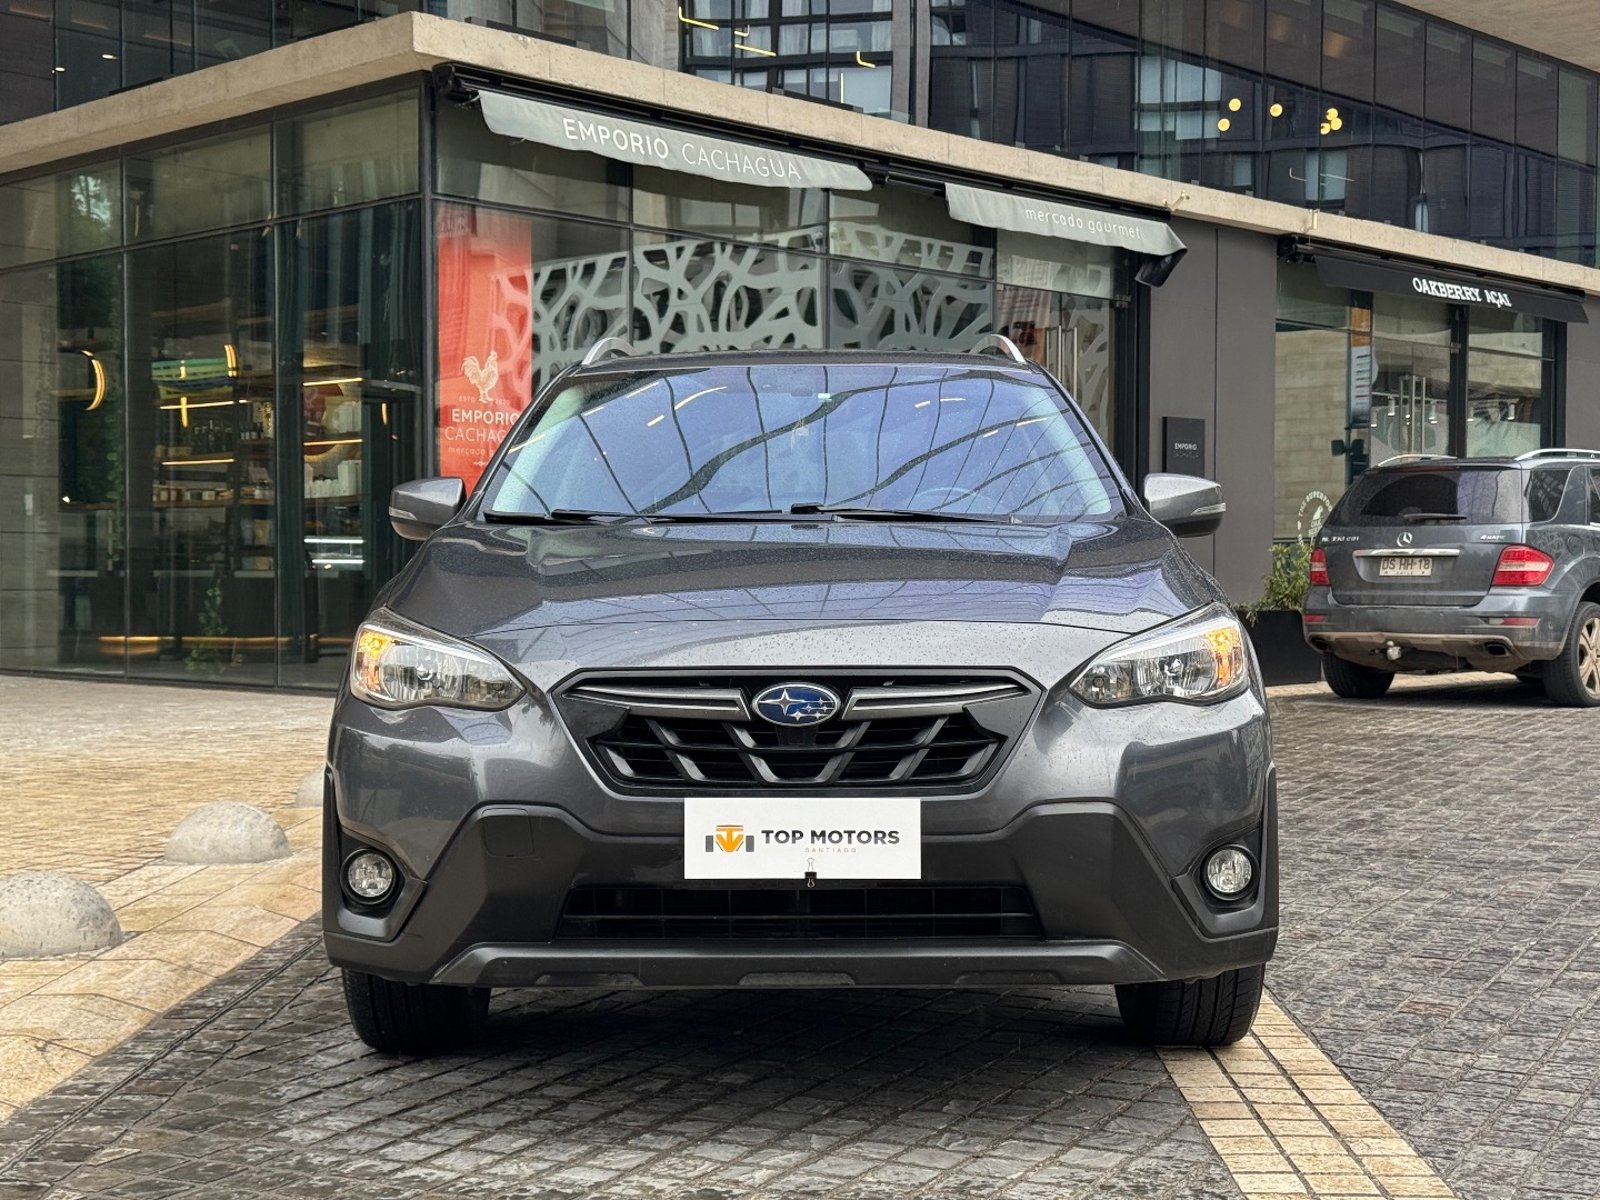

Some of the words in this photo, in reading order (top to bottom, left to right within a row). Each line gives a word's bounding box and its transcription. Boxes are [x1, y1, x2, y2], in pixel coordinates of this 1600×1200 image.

[562, 118, 669, 159] EMPORIO
[681, 143, 801, 180] CACHAGUA
[1025, 209, 1083, 229] mercado
[1088, 220, 1141, 239] gourmet
[1412, 277, 1482, 302] OAKBERRY
[451, 408, 520, 425] EMPORIO
[761, 830, 804, 844] TOP
[810, 830, 900, 845] MOTORS
